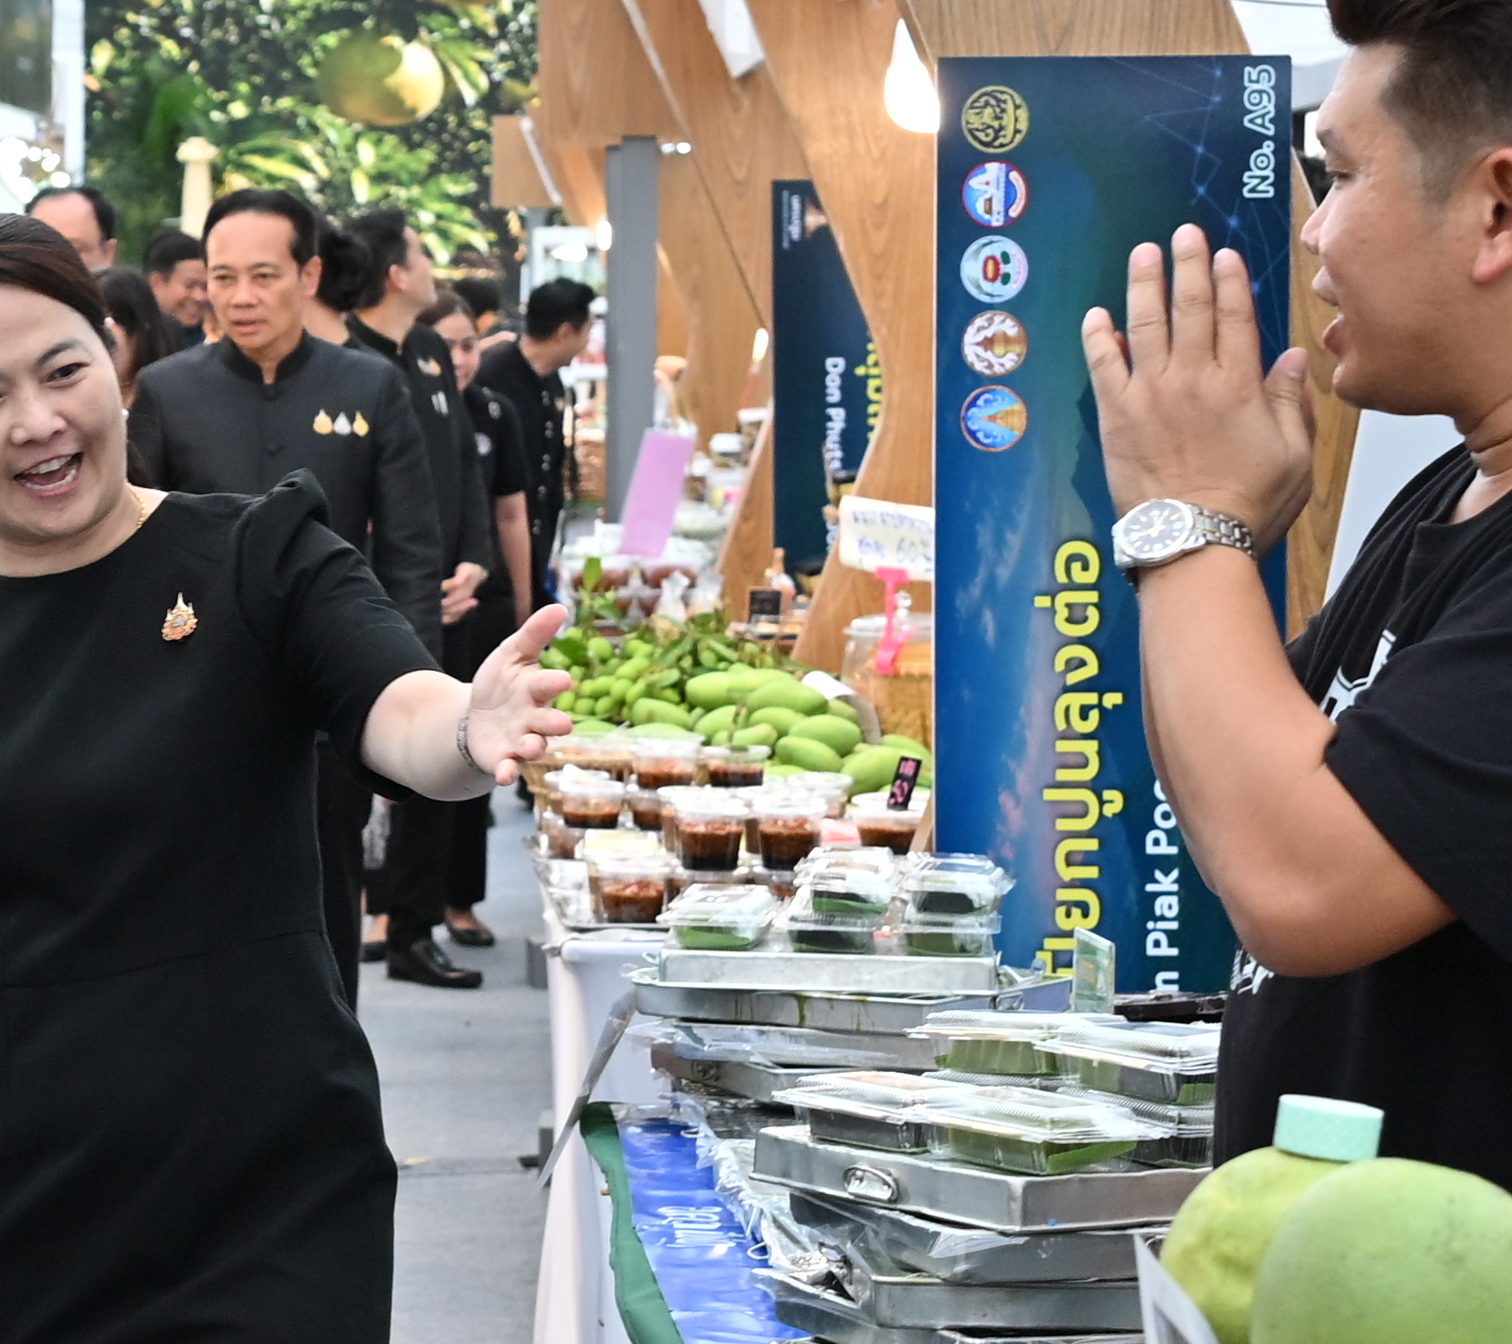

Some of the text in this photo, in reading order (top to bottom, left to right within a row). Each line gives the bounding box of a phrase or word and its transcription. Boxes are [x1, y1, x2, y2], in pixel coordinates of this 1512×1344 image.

[1242, 65, 1276, 198] No. A95
[1145, 867, 1180, 959] Piak
